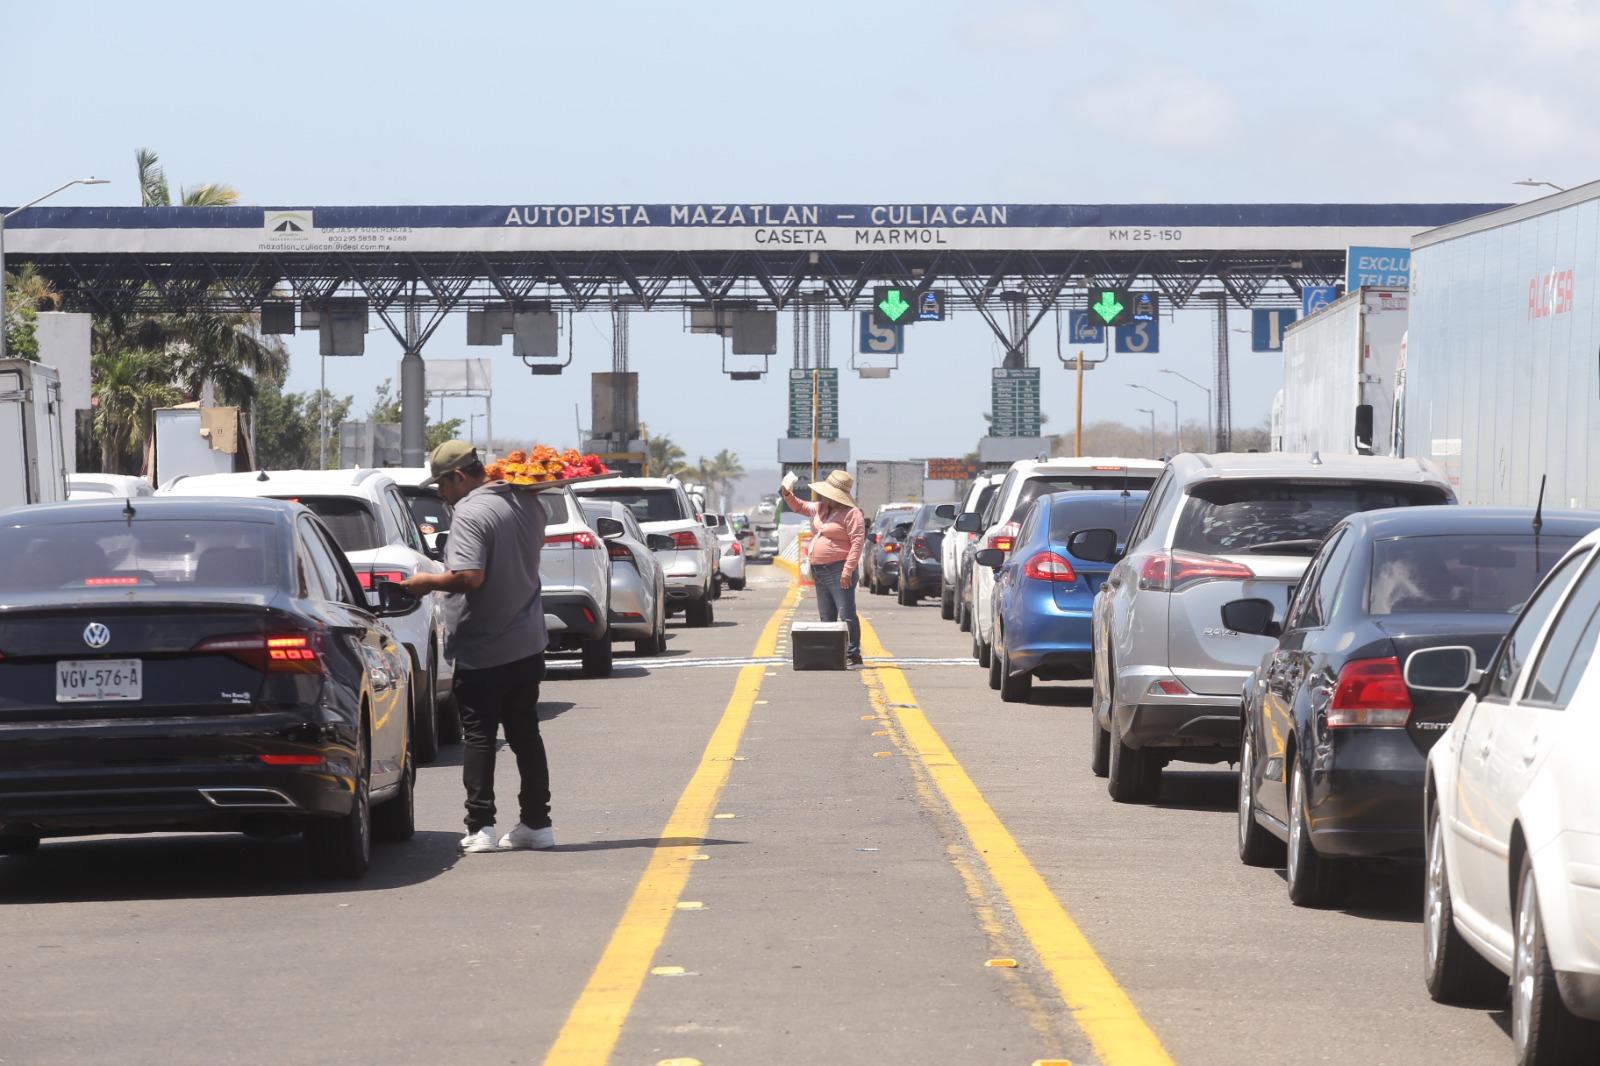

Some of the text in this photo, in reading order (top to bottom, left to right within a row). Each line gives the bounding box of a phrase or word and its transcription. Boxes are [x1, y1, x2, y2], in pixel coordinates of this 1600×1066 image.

[504, 206, 650, 226] AUTOPISTA
[670, 205, 819, 225] MAZATLAN
[870, 205, 1008, 225] CULIACAN
[754, 229, 947, 244] CASETA MARMOL
[1109, 230, 1182, 241] KM 25-150
[868, 314, 896, 351] 5
[1125, 322, 1149, 352] 3
[60, 668, 138, 688] VGV-576-A
